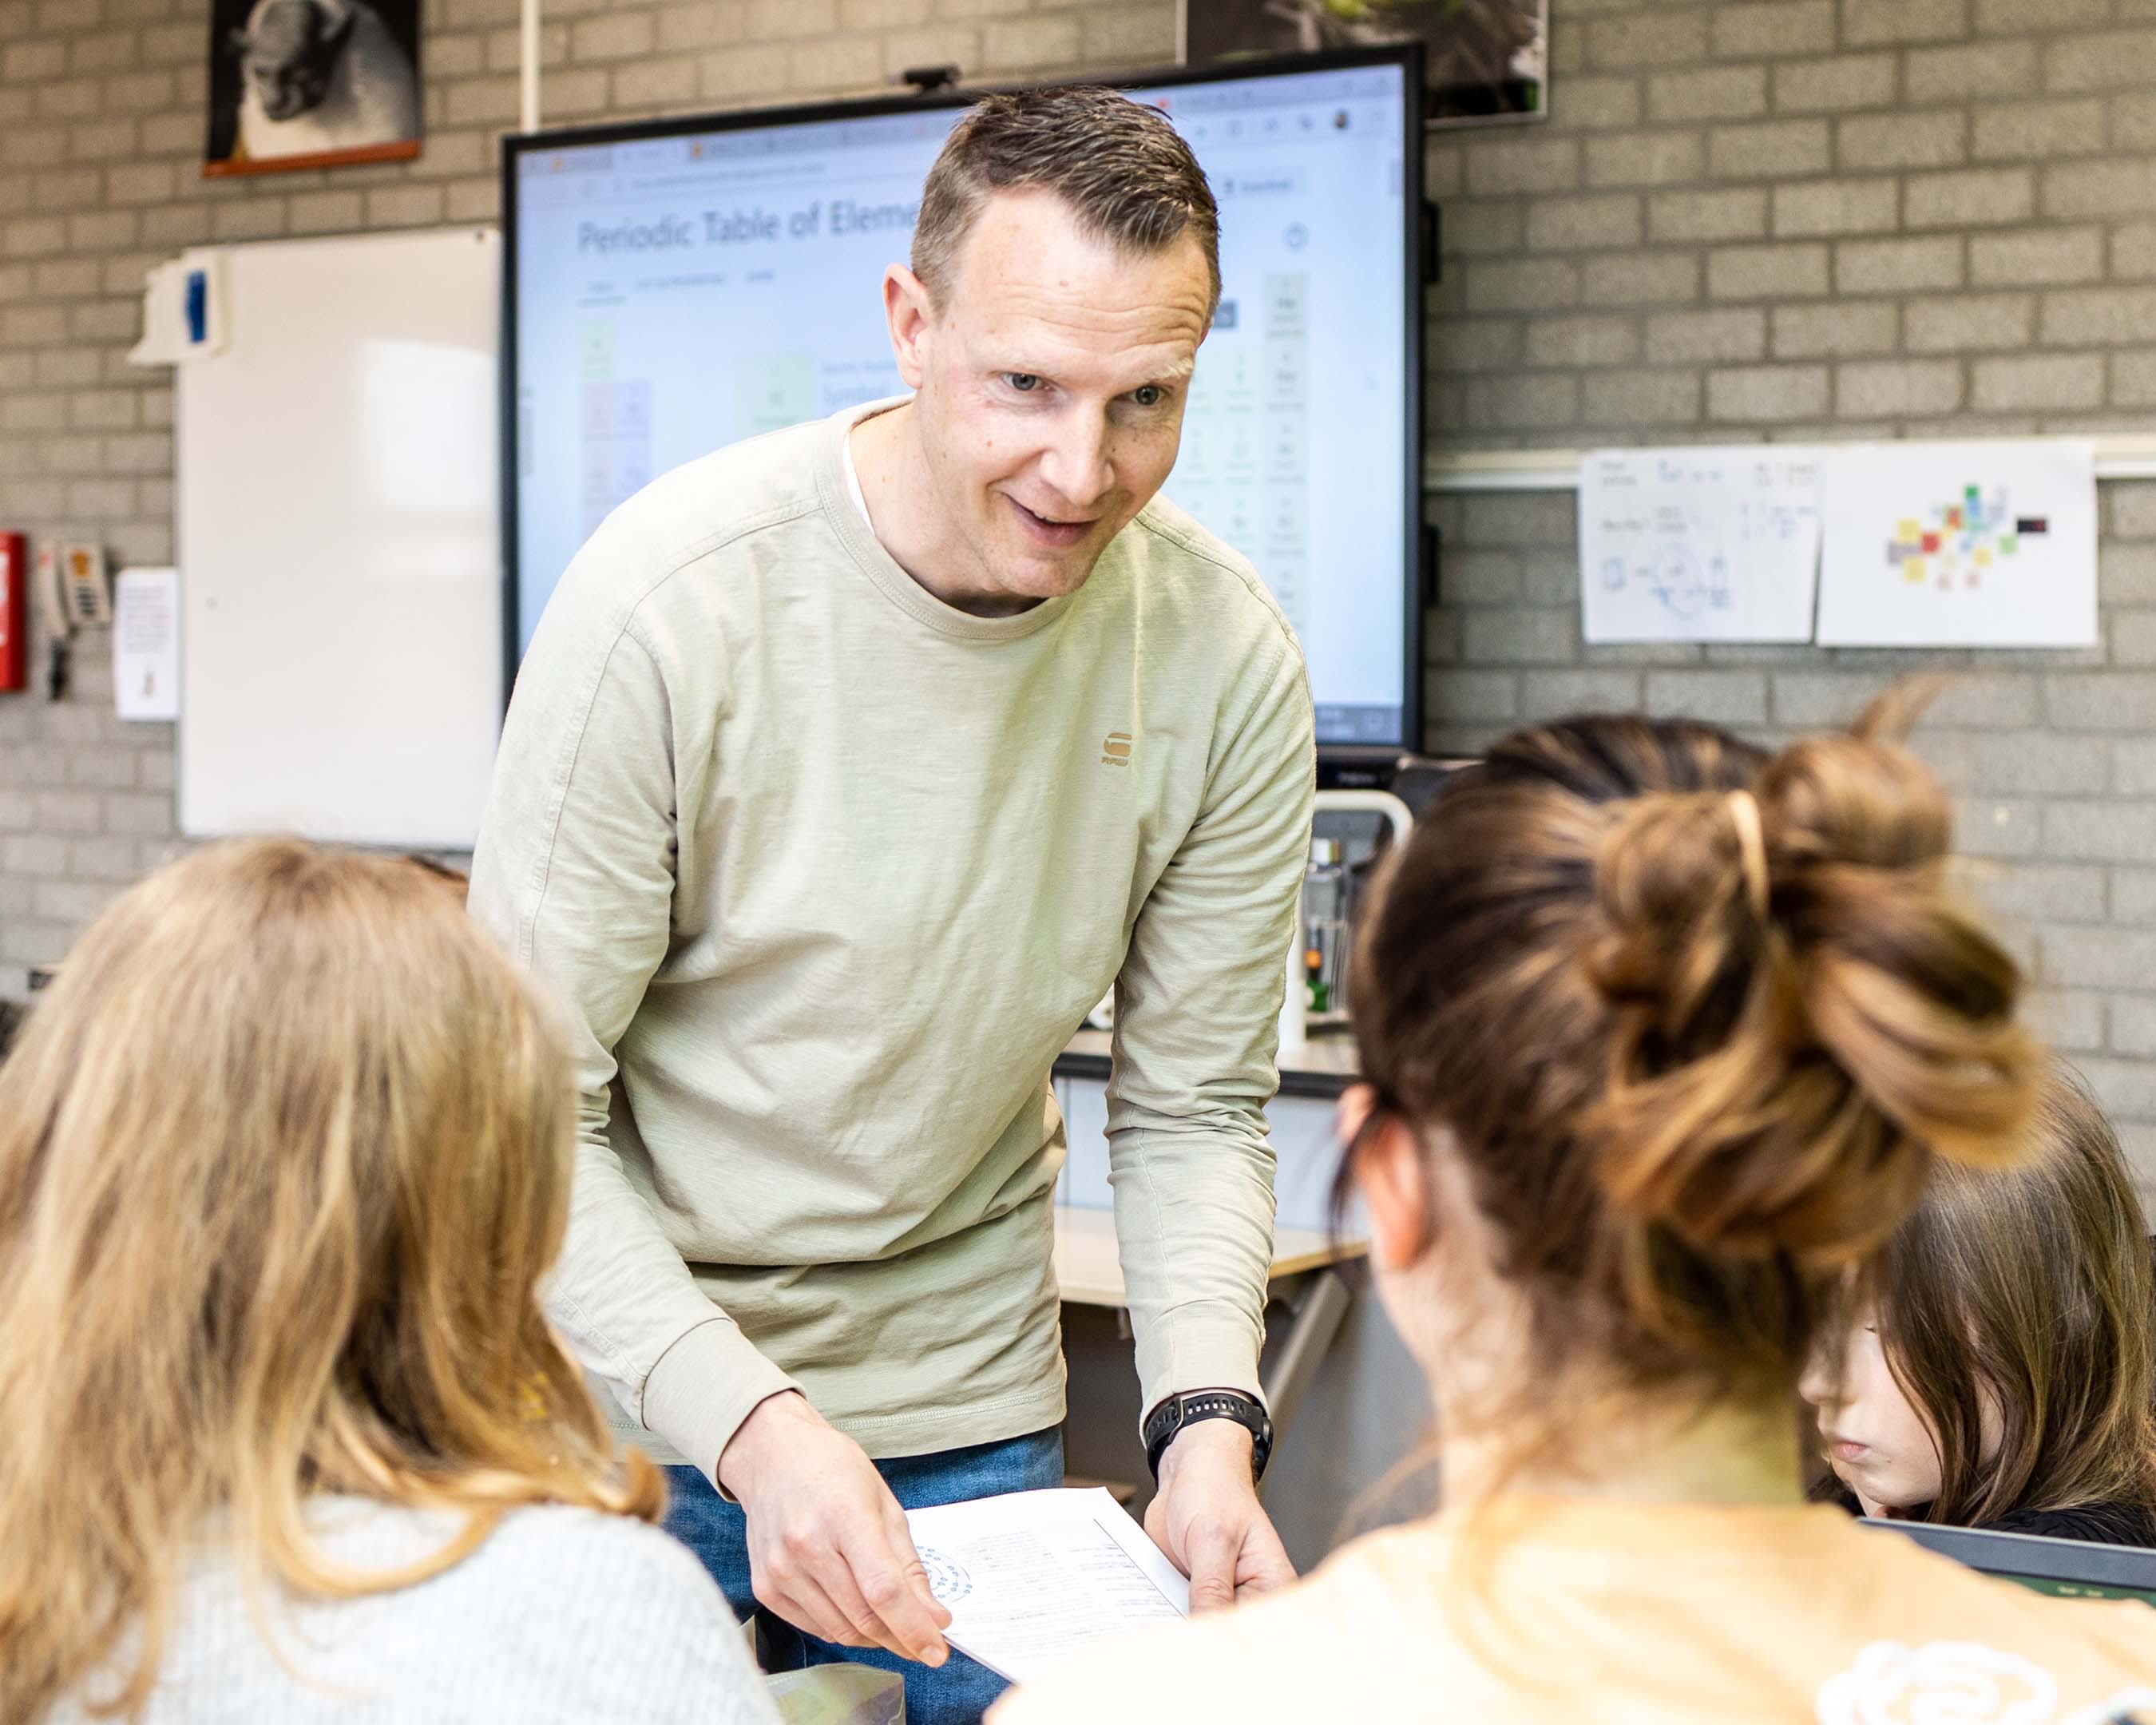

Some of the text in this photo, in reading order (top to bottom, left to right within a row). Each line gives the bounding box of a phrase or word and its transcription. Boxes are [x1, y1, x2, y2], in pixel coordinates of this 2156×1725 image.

[578, 198, 920, 252] Periodic Table of Eleme
